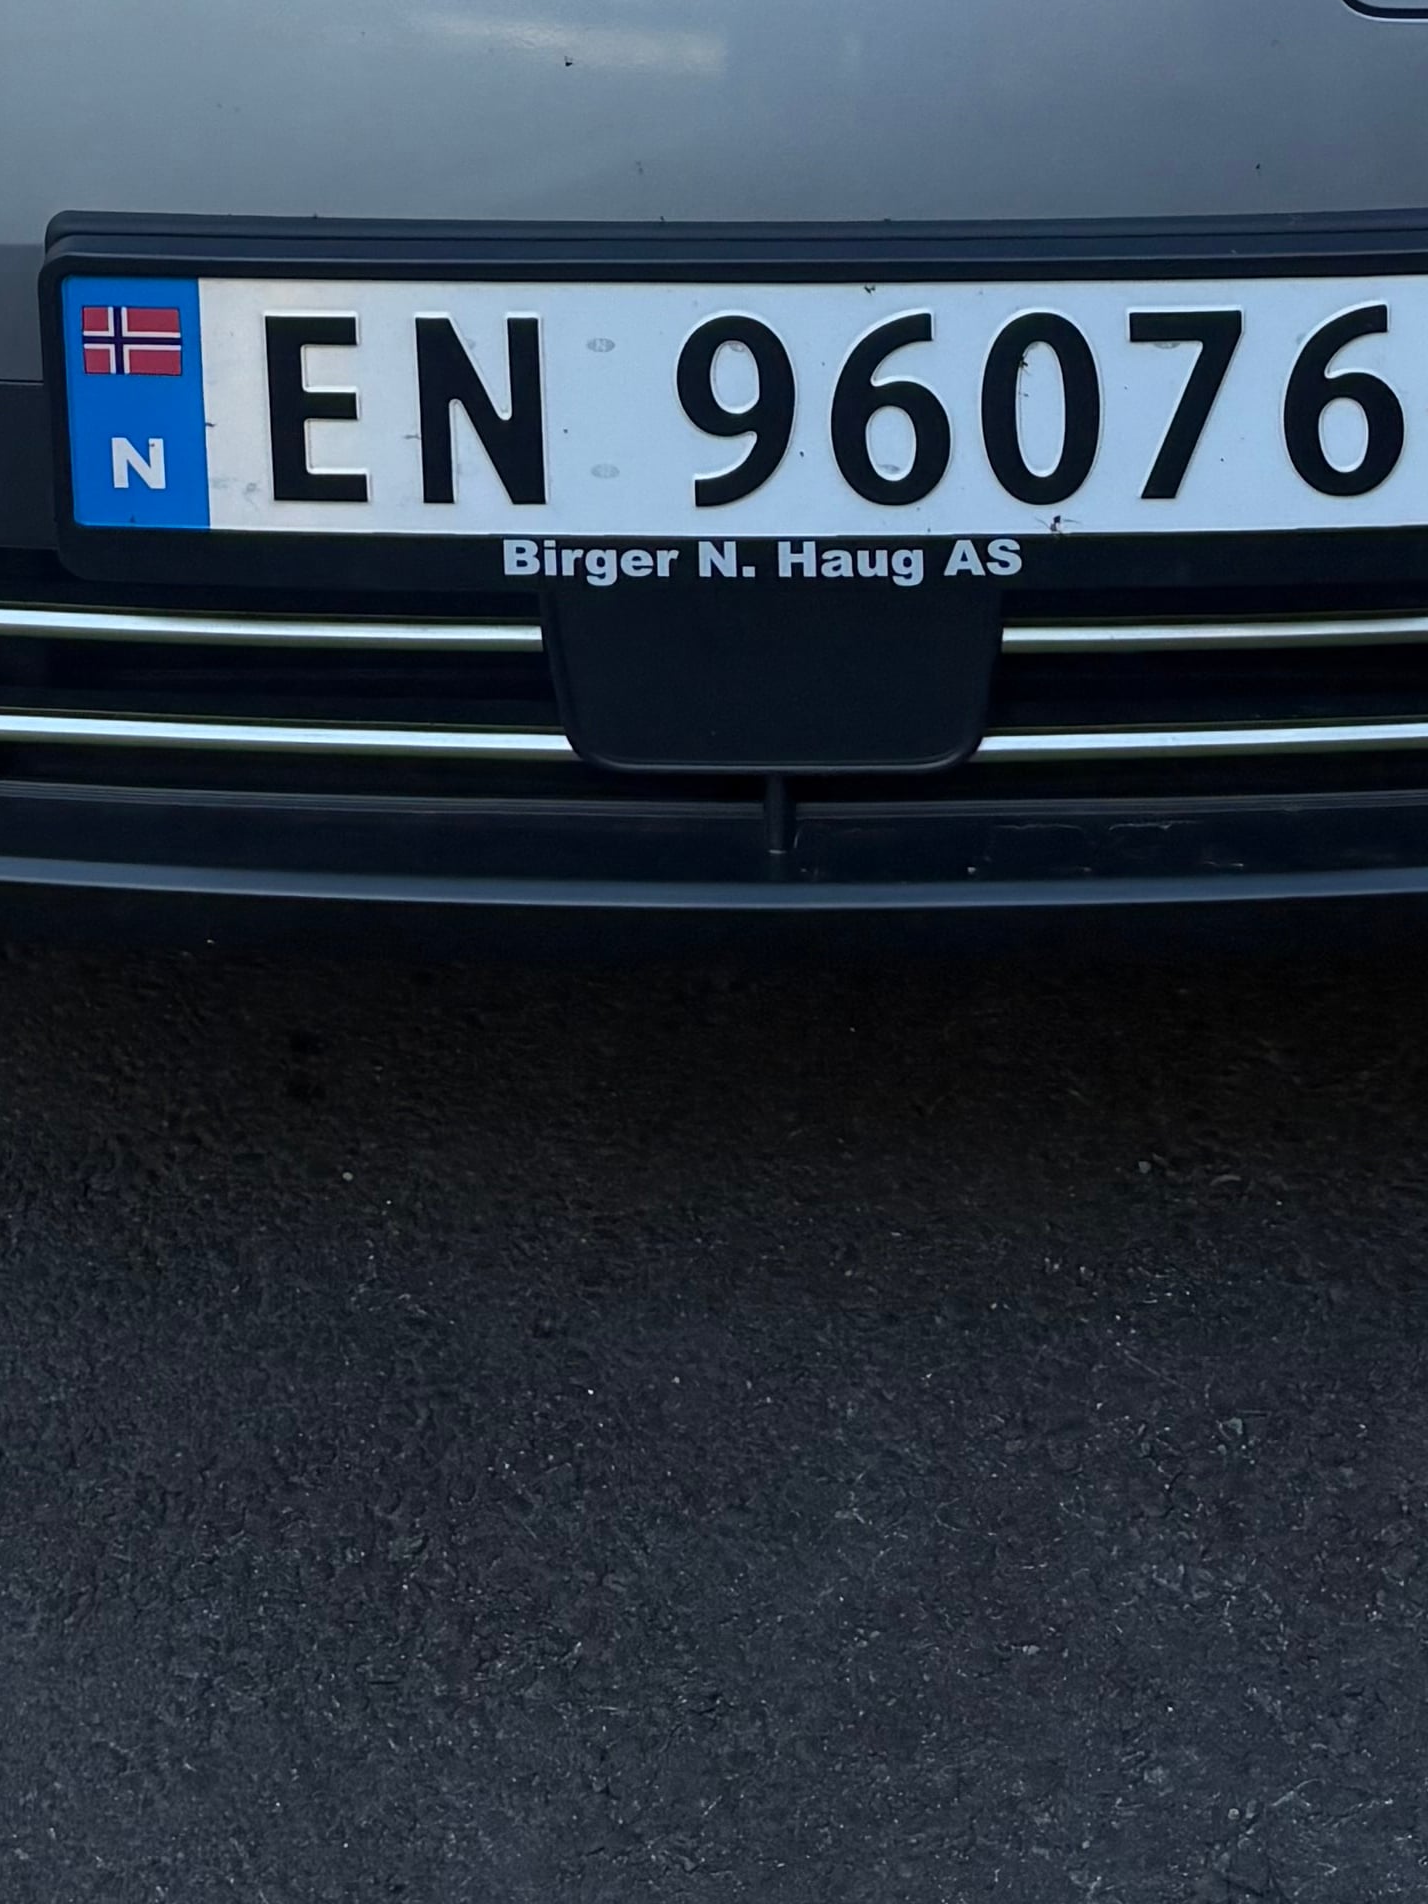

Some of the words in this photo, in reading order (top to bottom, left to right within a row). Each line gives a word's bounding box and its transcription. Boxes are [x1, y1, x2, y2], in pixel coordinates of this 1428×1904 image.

[264, 314, 548, 507] EN
[675, 303, 1406, 510] 96076
[111, 437, 167, 490] N
[503, 539, 680, 587] Birger
[698, 540, 756, 578] N.
[777, 540, 925, 587] Haug
[943, 538, 1023, 578] AS
